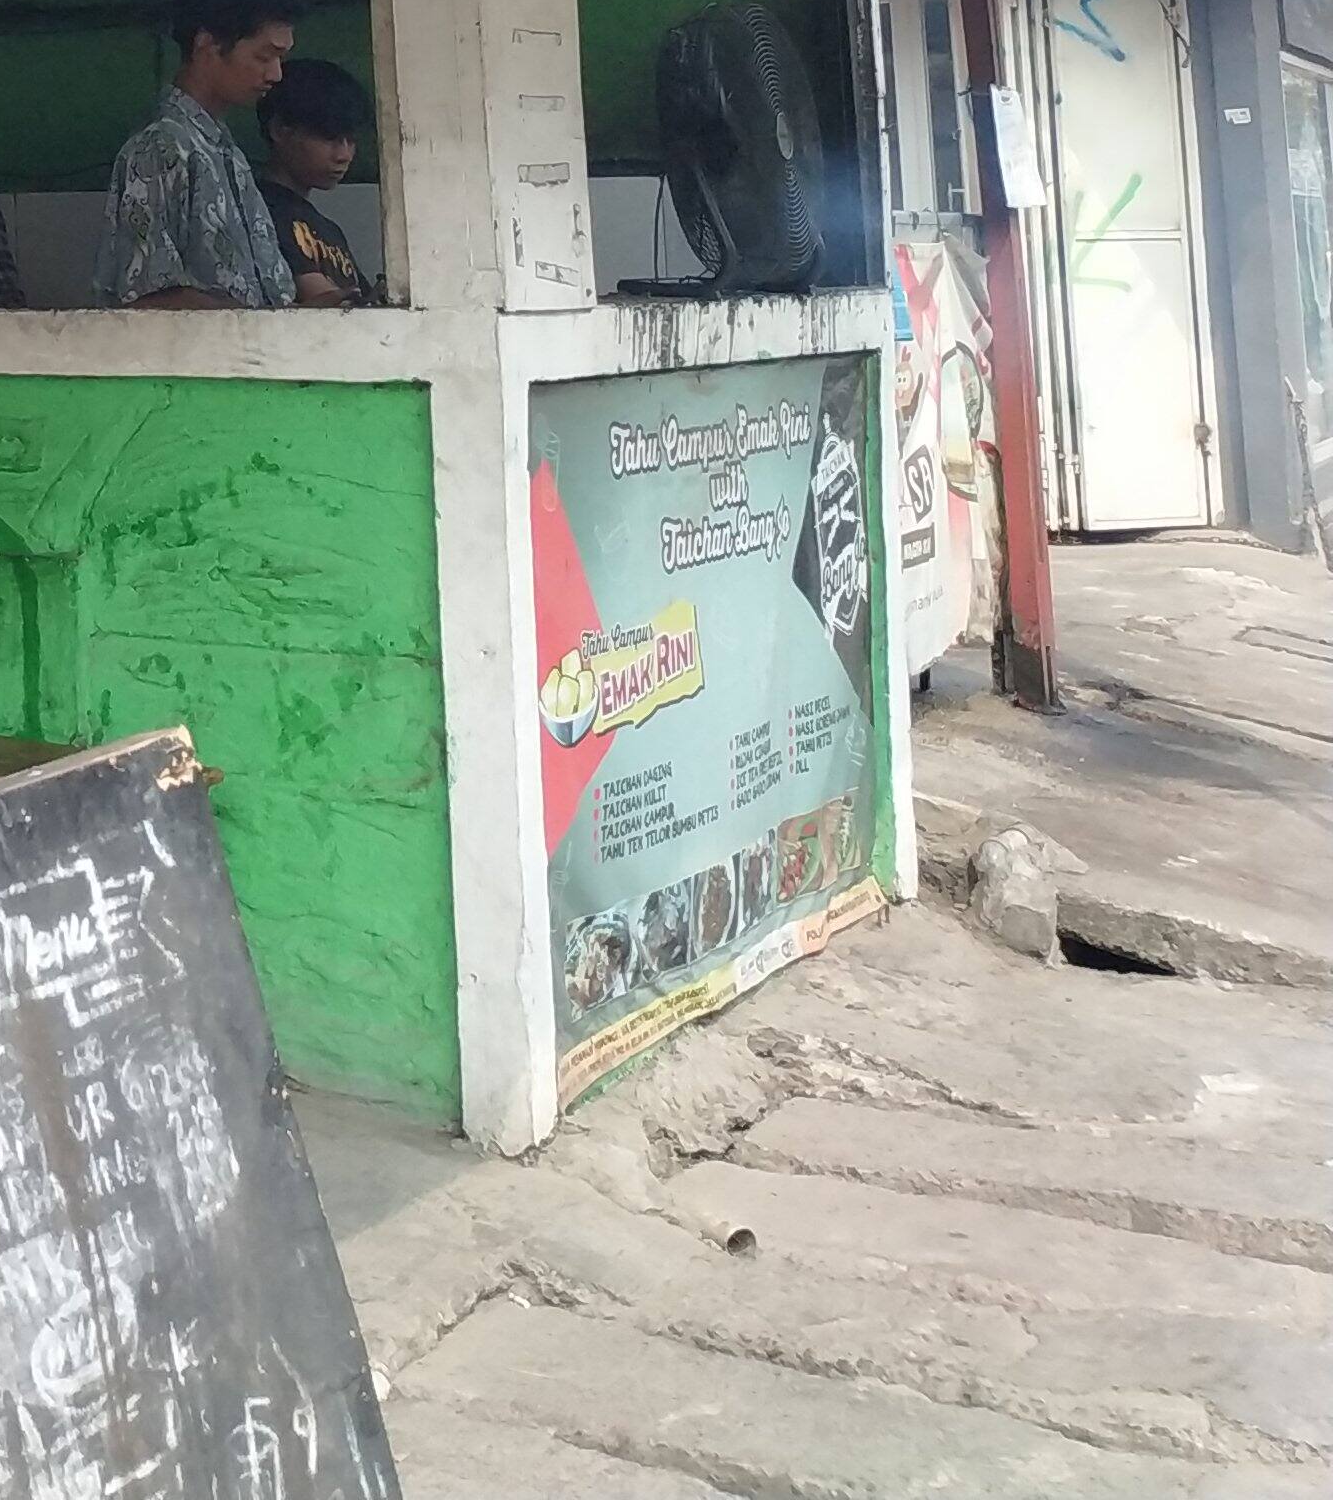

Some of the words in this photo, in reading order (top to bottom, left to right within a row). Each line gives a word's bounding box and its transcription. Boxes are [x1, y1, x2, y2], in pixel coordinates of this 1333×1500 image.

[610, 422, 661, 478] Tahu
[662, 416, 735, 472] Campur
[735, 403, 781, 458] Emak
[779, 399, 812, 459] Rini
[709, 463, 749, 509] with
[661, 517, 735, 572] Taichan
[734, 505, 777, 561] Bang
[581, 631, 609, 659] Tahu
[610, 622, 655, 652] Campur
[599, 652, 654, 717] EMAK
[655, 630, 695, 683] RINI
[602, 772, 643, 801] TAICHAN
[601, 793, 643, 822] TAICHAN
[600, 814, 643, 843] TAICHAN
[599, 840, 626, 864] TAHU
